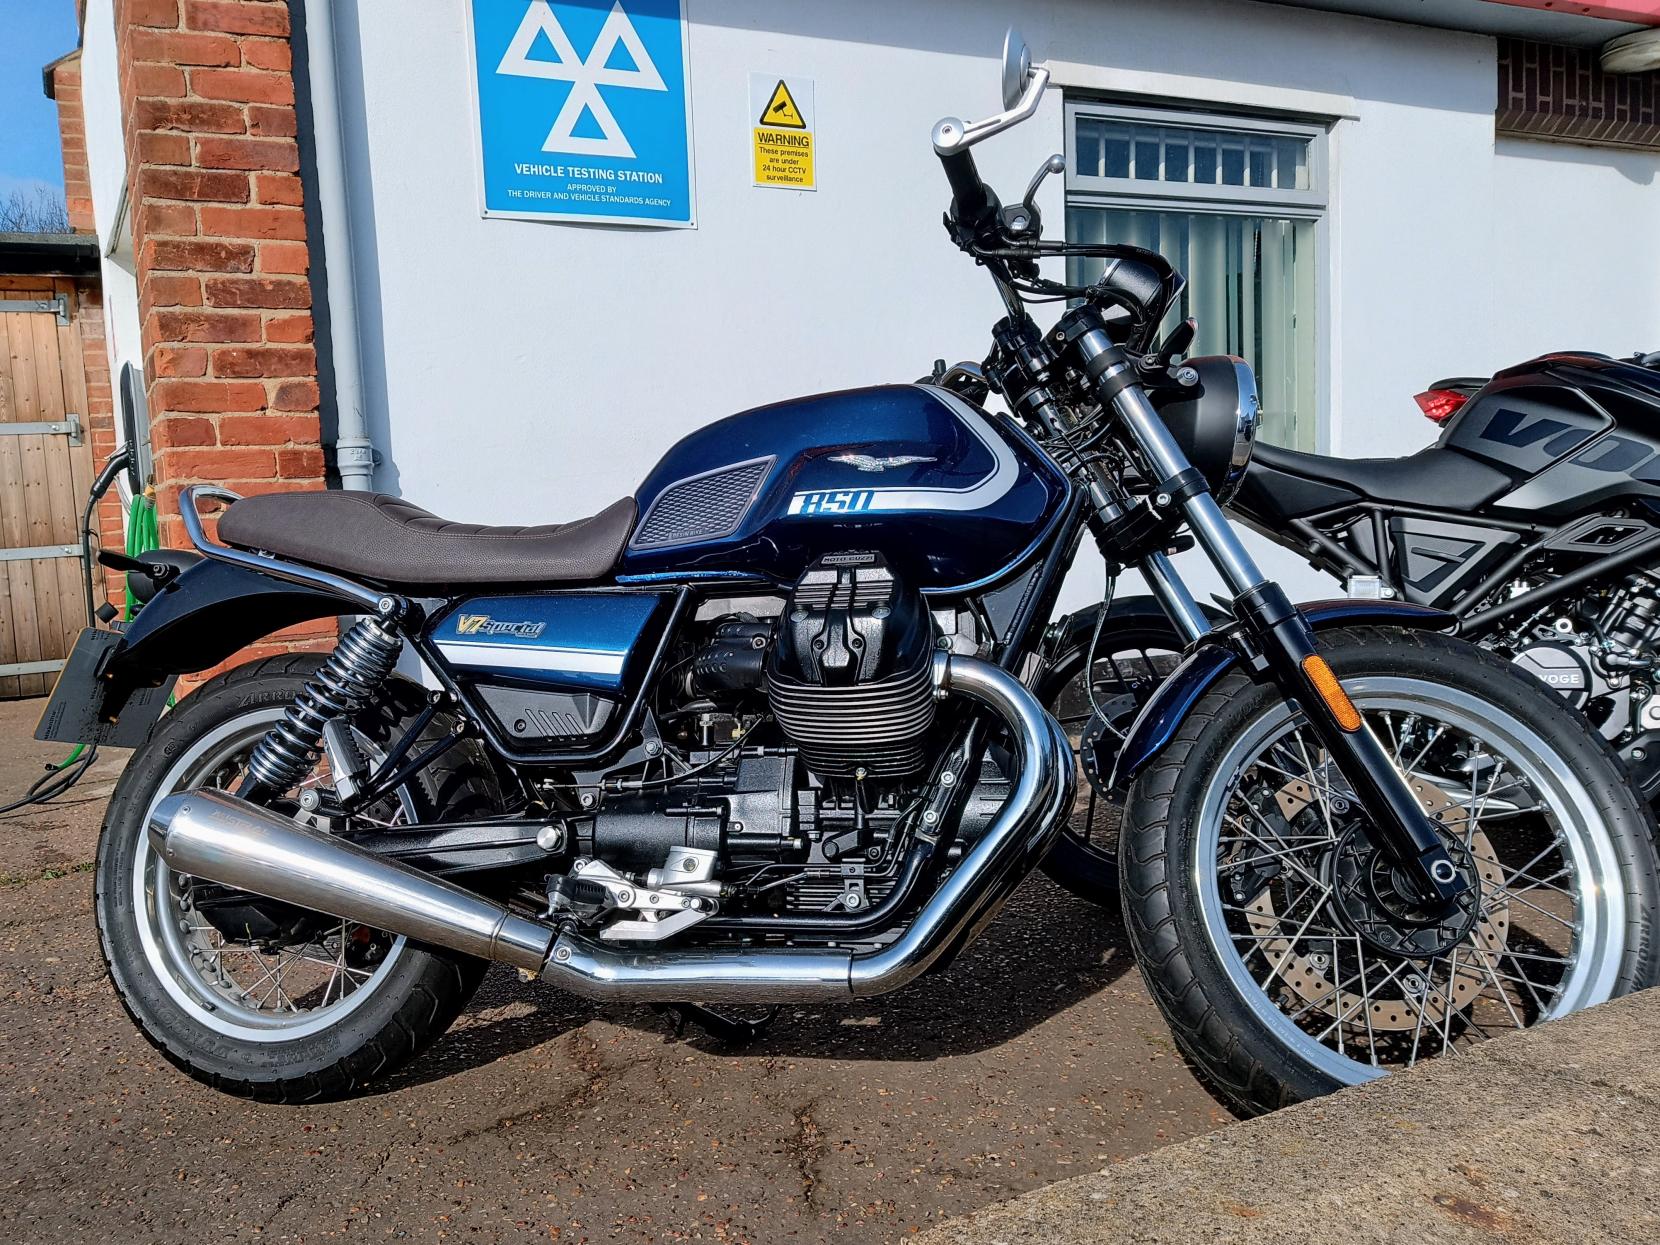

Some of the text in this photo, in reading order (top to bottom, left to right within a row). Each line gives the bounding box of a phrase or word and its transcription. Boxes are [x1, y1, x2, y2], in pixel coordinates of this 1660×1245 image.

[758, 132, 810, 147] WARNING
[759, 146, 809, 158] These premises
[514, 163, 663, 184] VEHICLE TESTING STATION
[762, 164, 807, 174] 24 hour CCTV
[766, 175, 804, 183] surveillance
[566, 183, 617, 194] APPROVED BY
[507, 189, 672, 207] THE DRIVER AND VEHICLE STANDARDS AGENCY
[1479, 408, 1660, 482] VO
[801, 490, 876, 514] 850
[823, 554, 874, 563] MOTO GUZZI
[1539, 674, 1580, 684] VOGE
